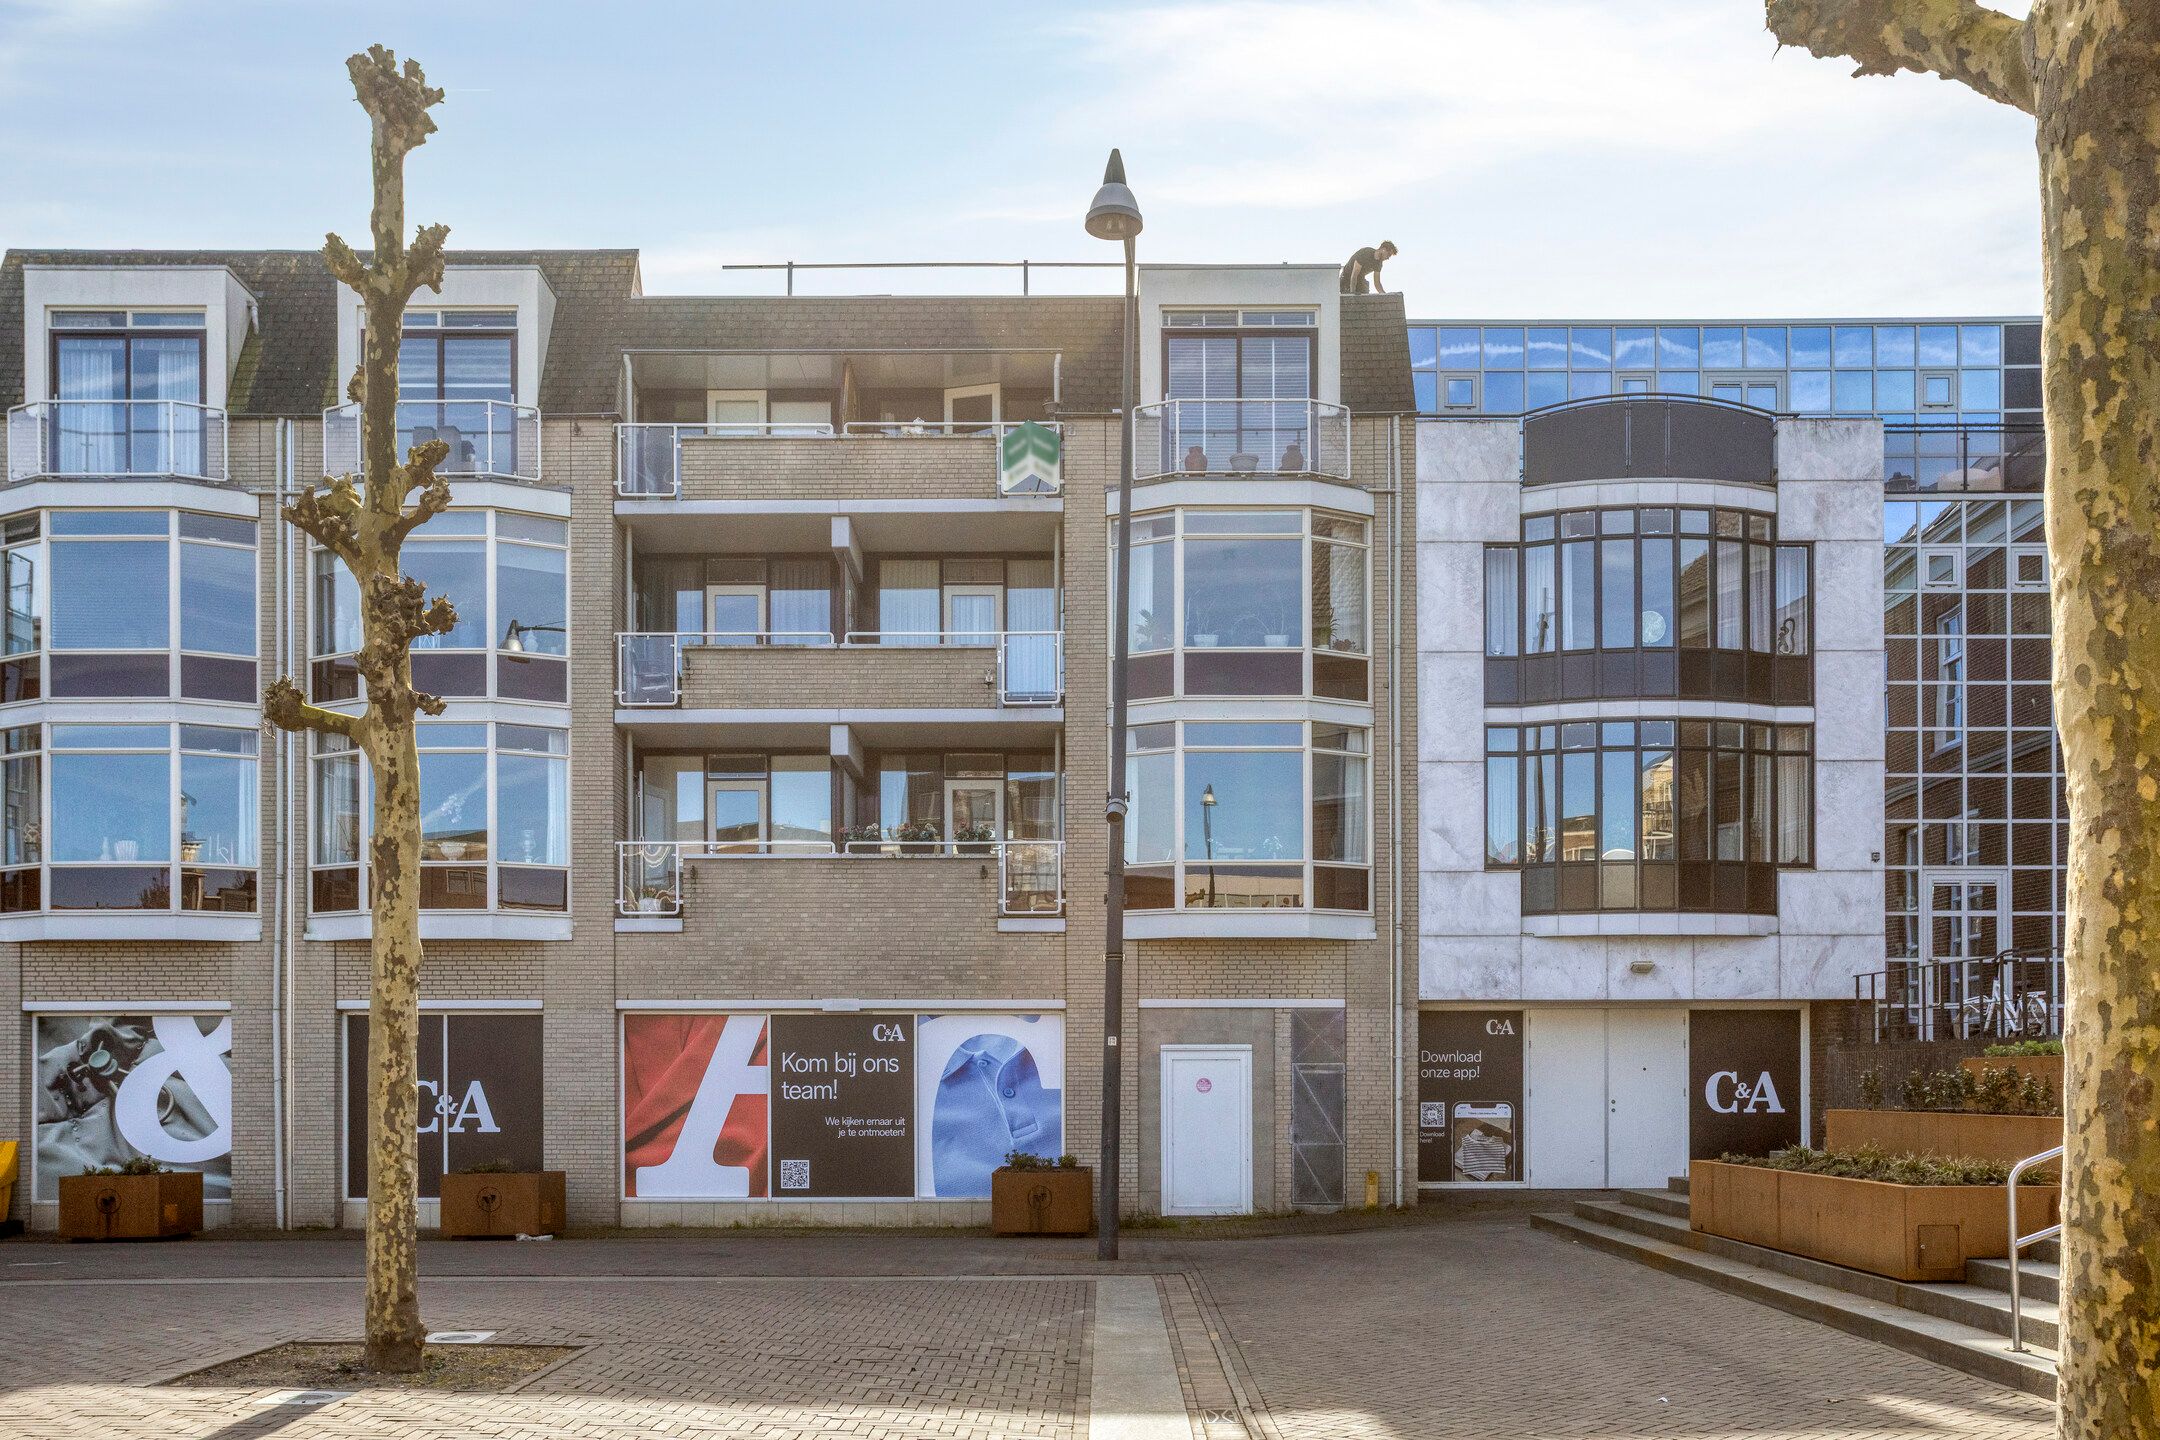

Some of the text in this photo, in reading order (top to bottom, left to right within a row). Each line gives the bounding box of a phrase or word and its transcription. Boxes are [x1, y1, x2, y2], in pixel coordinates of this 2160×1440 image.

[872, 1023, 906, 1042] C&A
[1485, 1019, 1515, 1035] C&A
[782, 1051, 900, 1078] Kom bij ons
[1421, 1050, 1482, 1063] Download
[1420, 1065, 1480, 1080] onze app!
[781, 1079, 838, 1100] team!
[1705, 1071, 1786, 1113] C&A
[825, 1116, 906, 1127] We kijken ernaar uit
[837, 1127, 906, 1139] je te ontmoeten!
